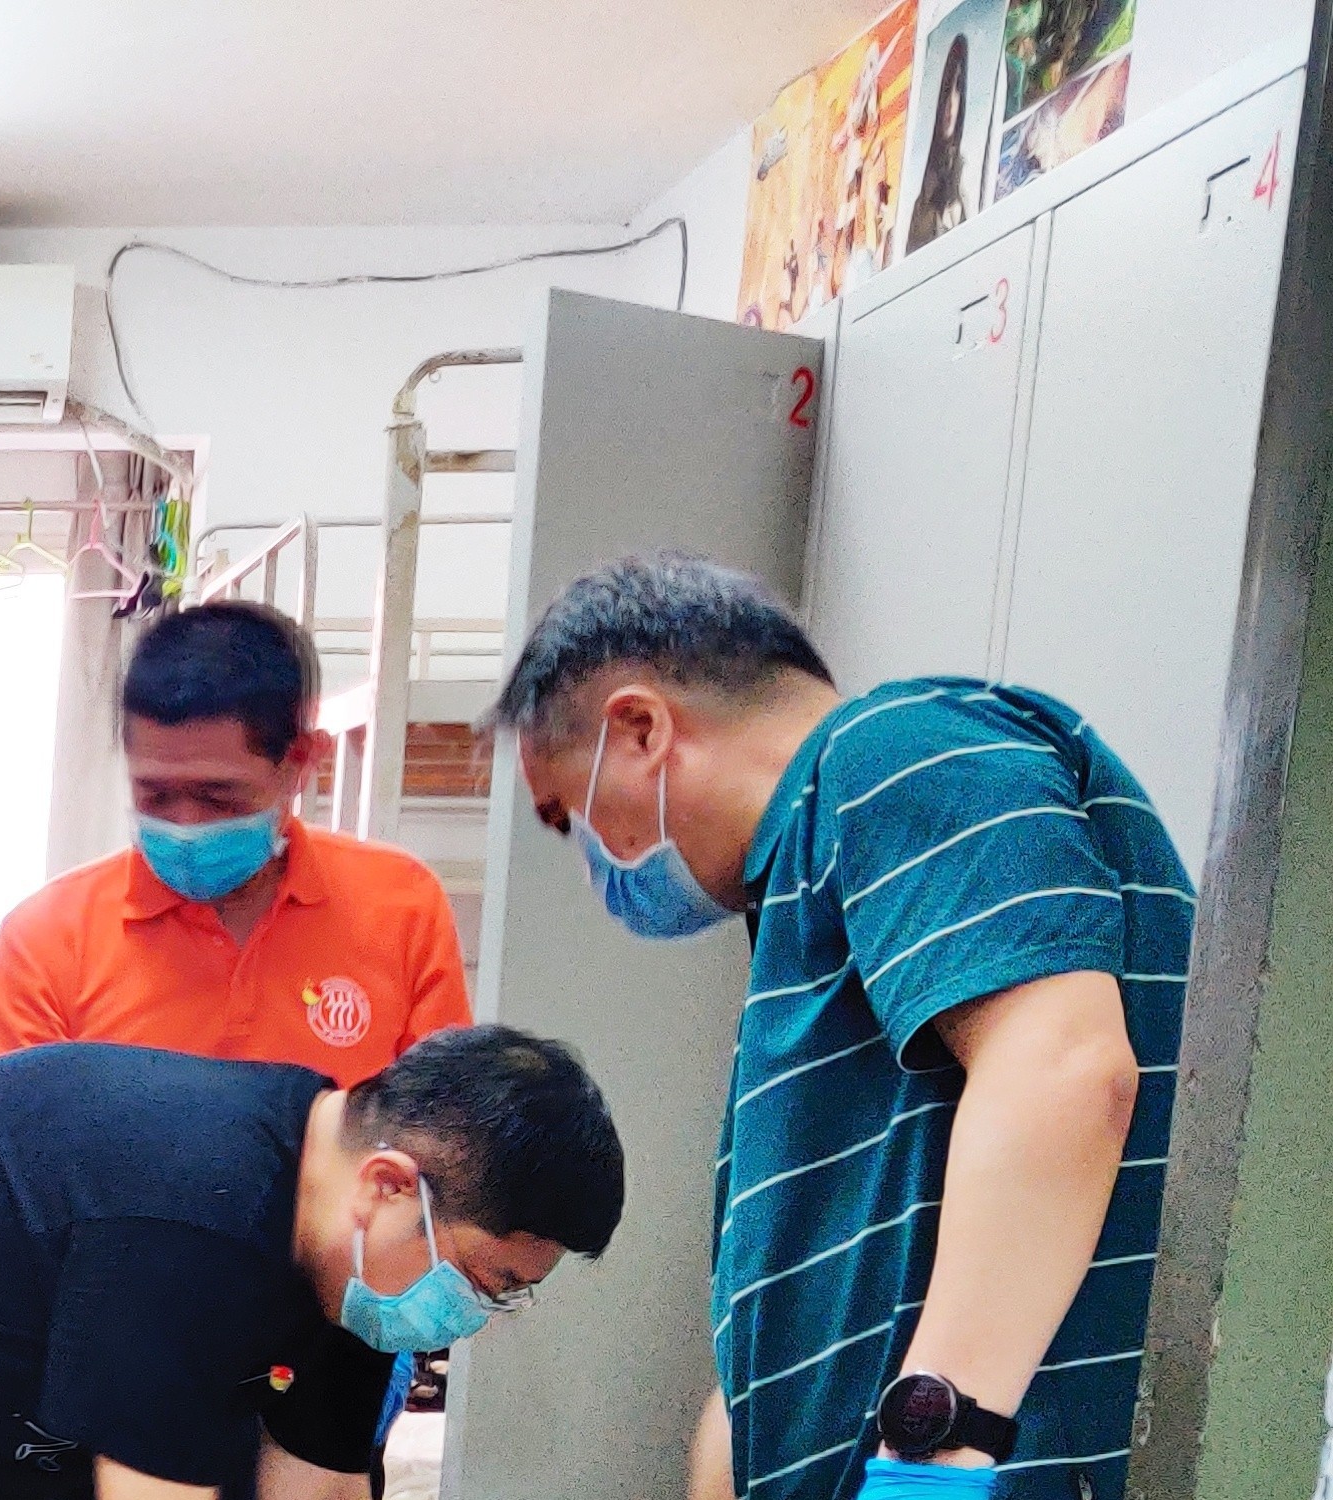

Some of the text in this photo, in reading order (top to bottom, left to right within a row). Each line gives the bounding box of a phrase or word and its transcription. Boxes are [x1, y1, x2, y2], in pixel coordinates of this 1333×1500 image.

[1253, 130, 1281, 210] 4
[988, 278, 1009, 343] 3
[789, 366, 815, 428] 2
